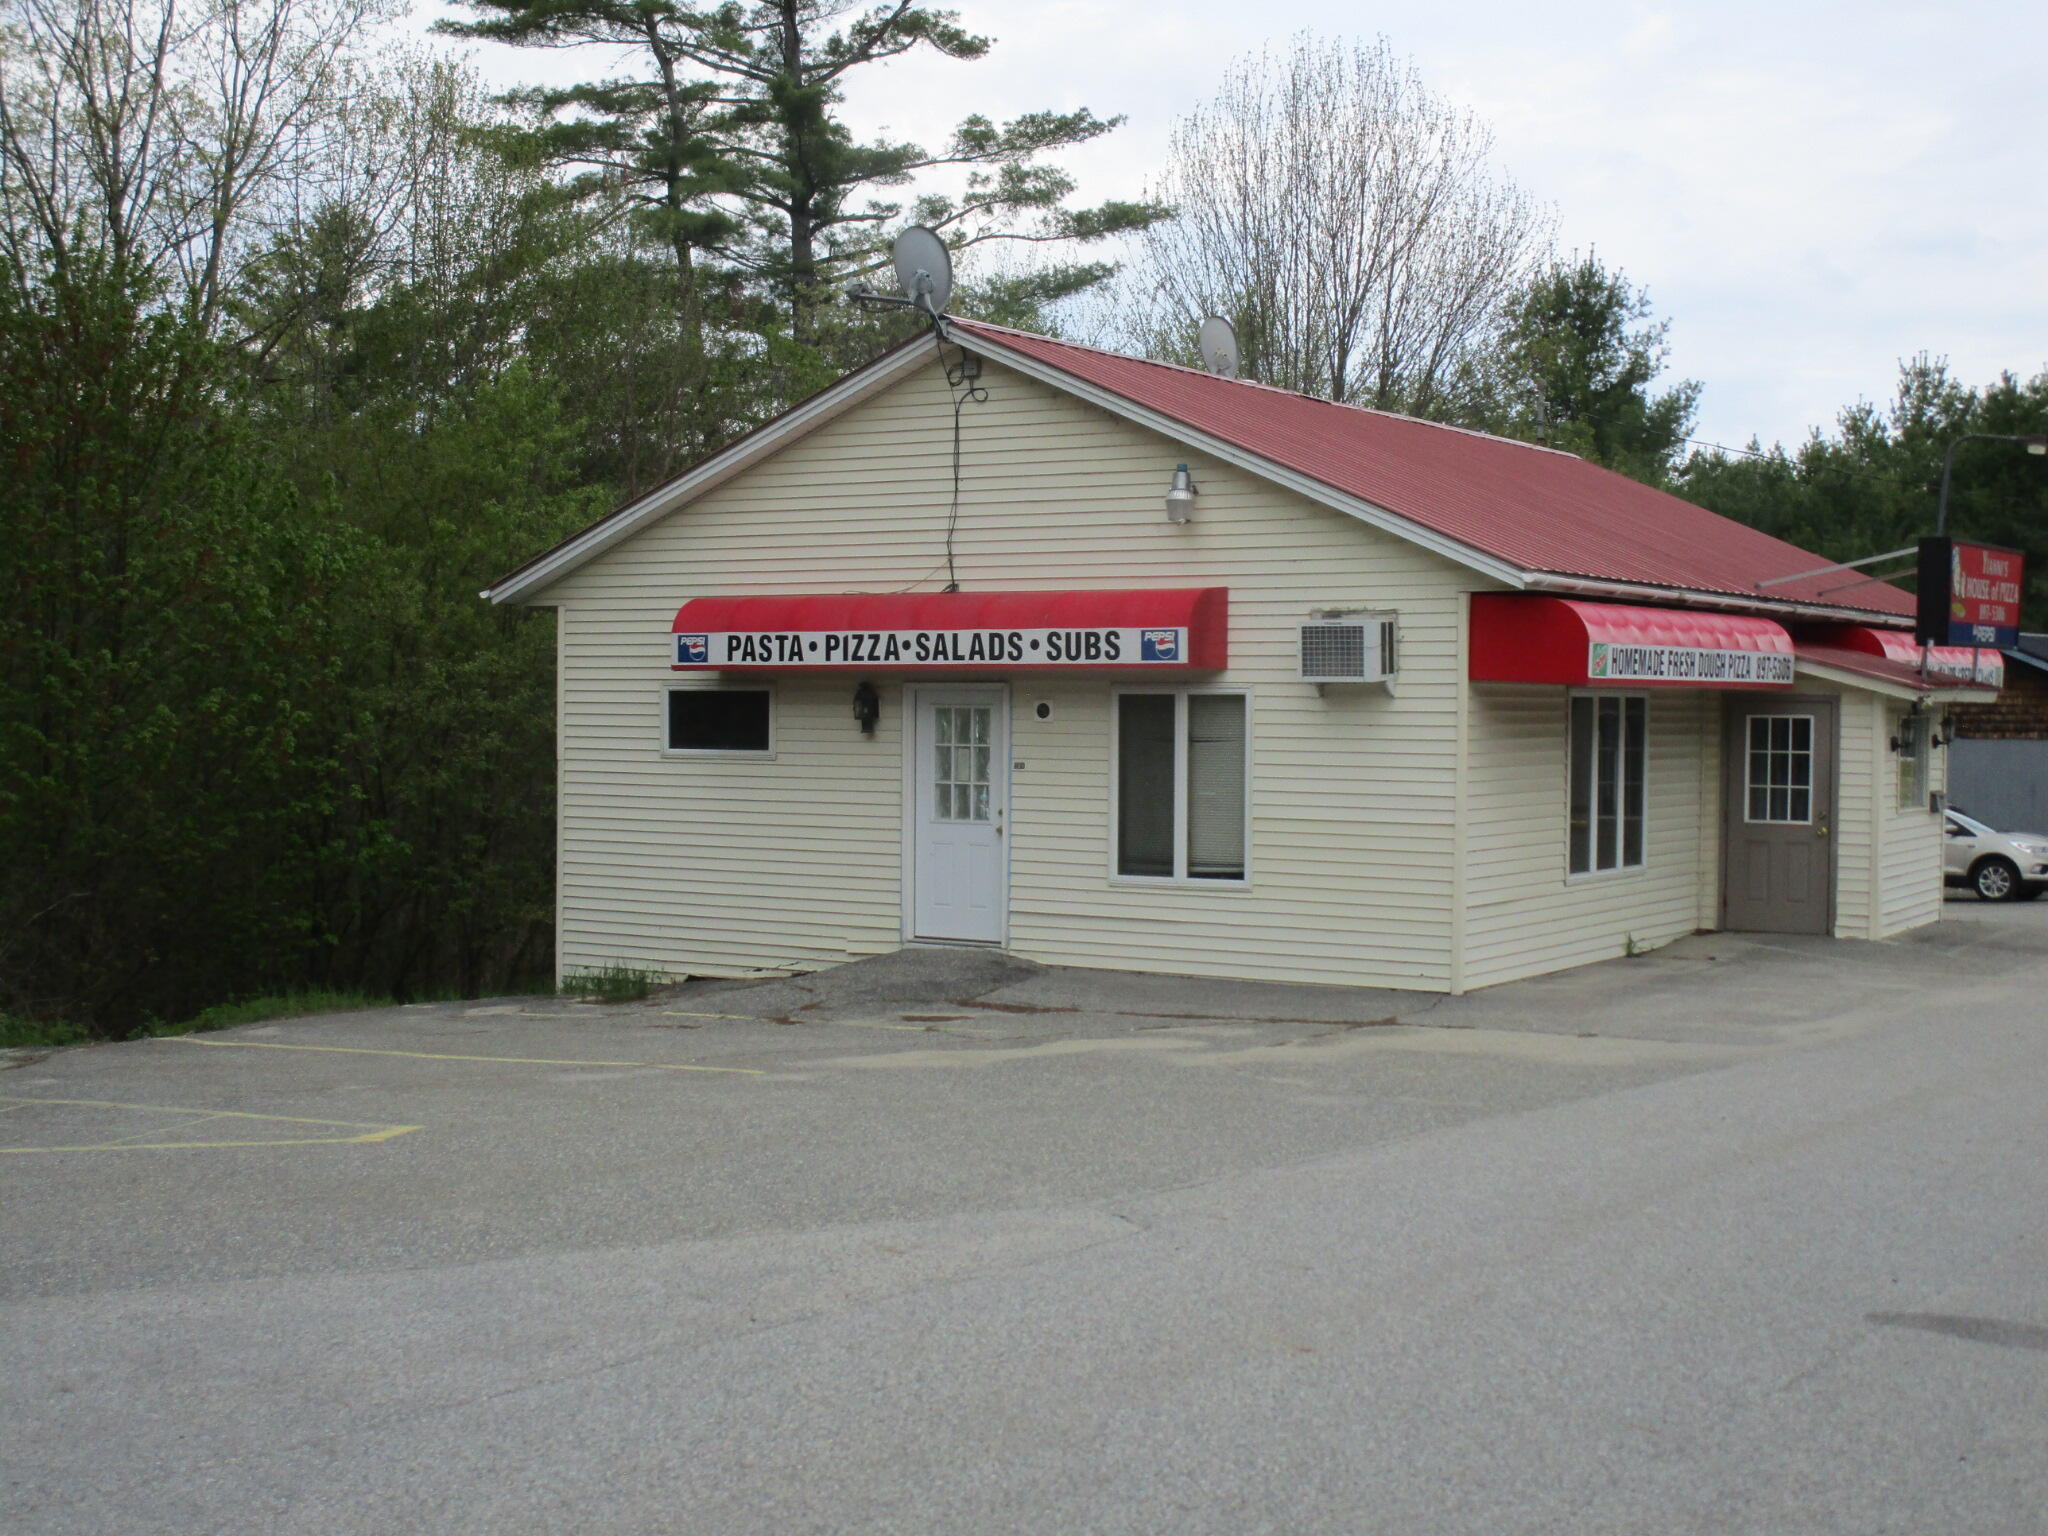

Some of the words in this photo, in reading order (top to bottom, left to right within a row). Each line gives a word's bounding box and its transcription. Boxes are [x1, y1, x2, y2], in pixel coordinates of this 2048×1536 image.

[1966, 577, 1989, 600] HOUSE
[2000, 582, 2019, 604] PIZZA
[680, 636, 705, 646] PEPSI
[727, 634, 804, 662] PASTA
[825, 634, 900, 662] PIZZA
[915, 632, 1023, 662] SALADS
[1046, 630, 1121, 661] SUBS
[1144, 631, 1175, 642] PEPSI
[1611, 647, 1665, 676] HOMEMADE
[1667, 650, 1696, 677] FRESH
[1698, 652, 1727, 678] DOUGH
[1728, 654, 1751, 679] PIZZA
